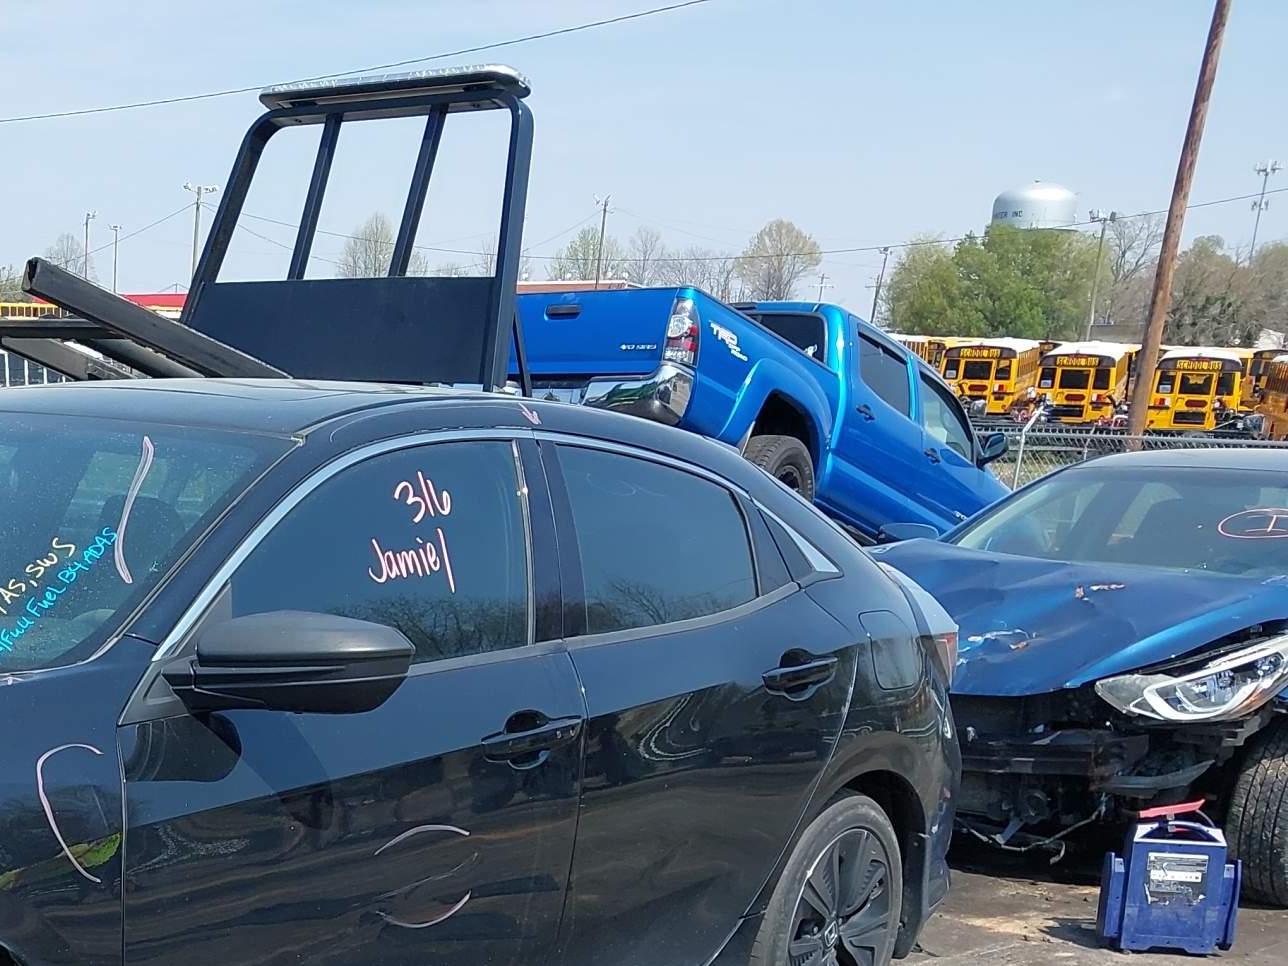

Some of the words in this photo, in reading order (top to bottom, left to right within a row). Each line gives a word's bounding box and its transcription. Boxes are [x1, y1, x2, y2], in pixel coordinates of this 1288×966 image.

[960, 348, 984, 359] SCHOOL
[988, 348, 1001, 359] BUS
[1057, 356, 1081, 367] SCHOOL
[1087, 356, 1100, 367] BUS
[1176, 360, 1202, 370] SCHOOL
